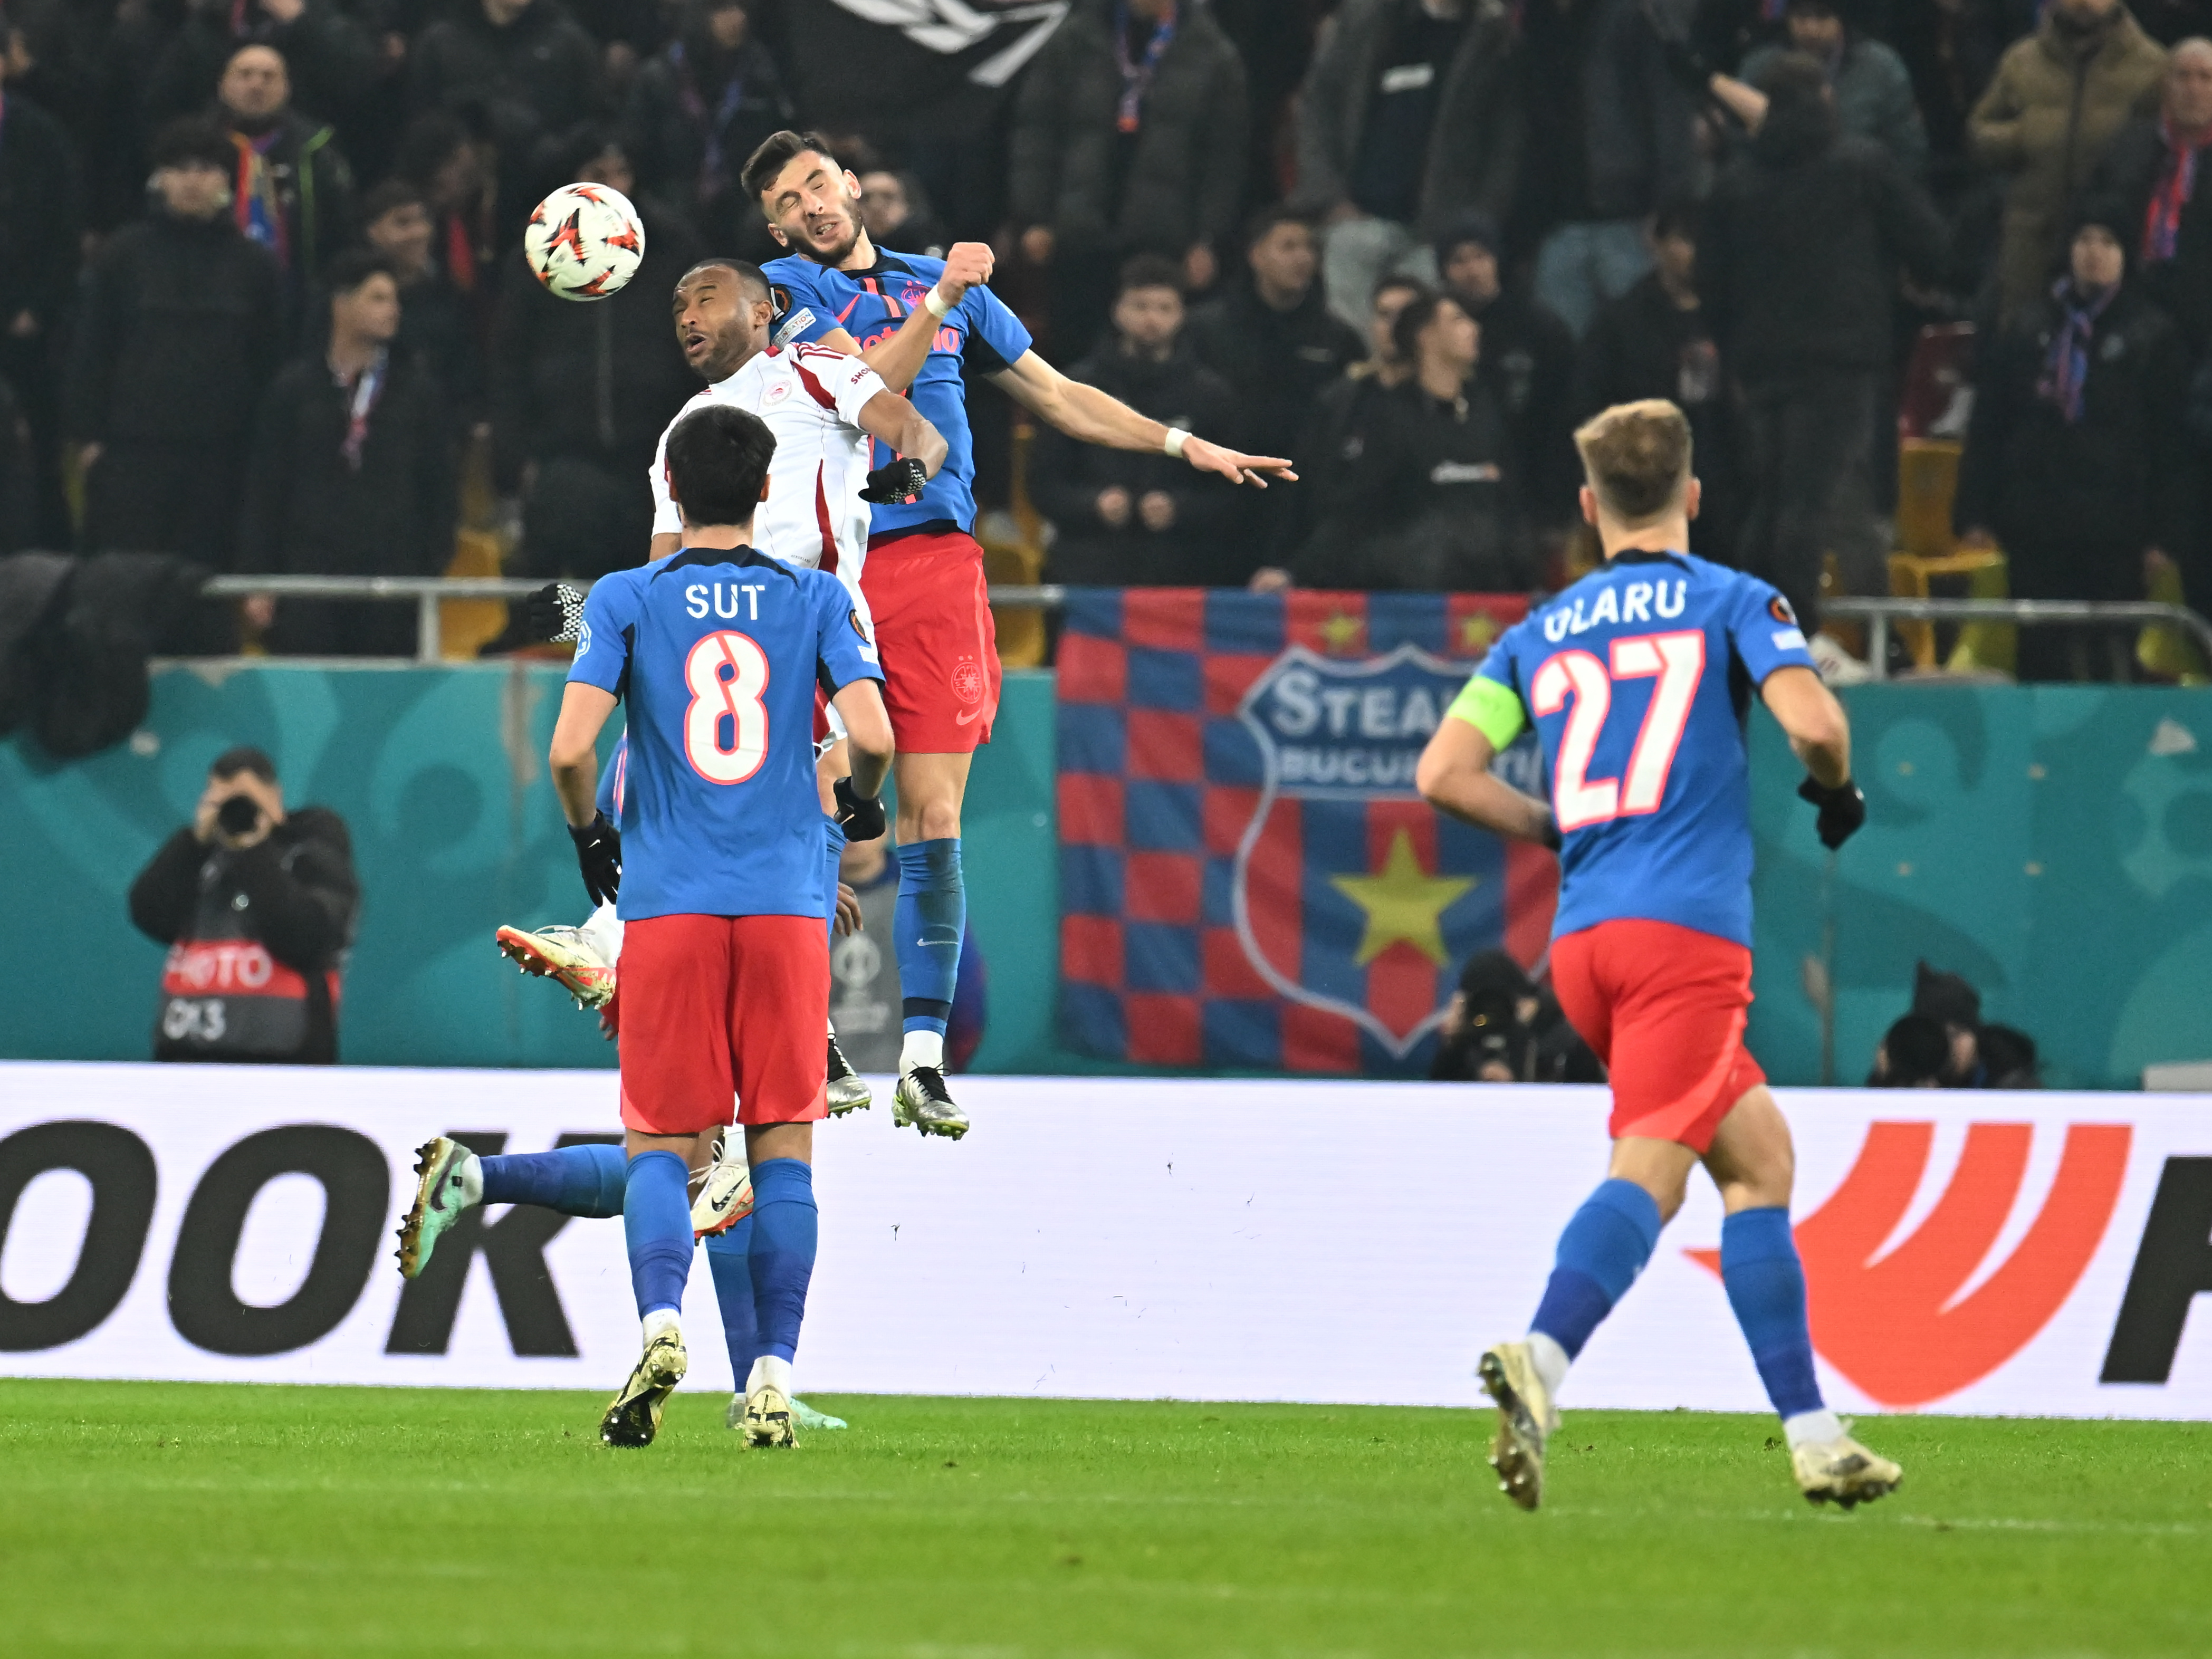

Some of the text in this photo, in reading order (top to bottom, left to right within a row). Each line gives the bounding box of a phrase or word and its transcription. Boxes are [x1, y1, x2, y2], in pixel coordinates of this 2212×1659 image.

[685, 582, 765, 620] SUT
[684, 629, 770, 785] 8
[1273, 670, 1453, 737] STEA
[1531, 628, 1706, 833] 27
